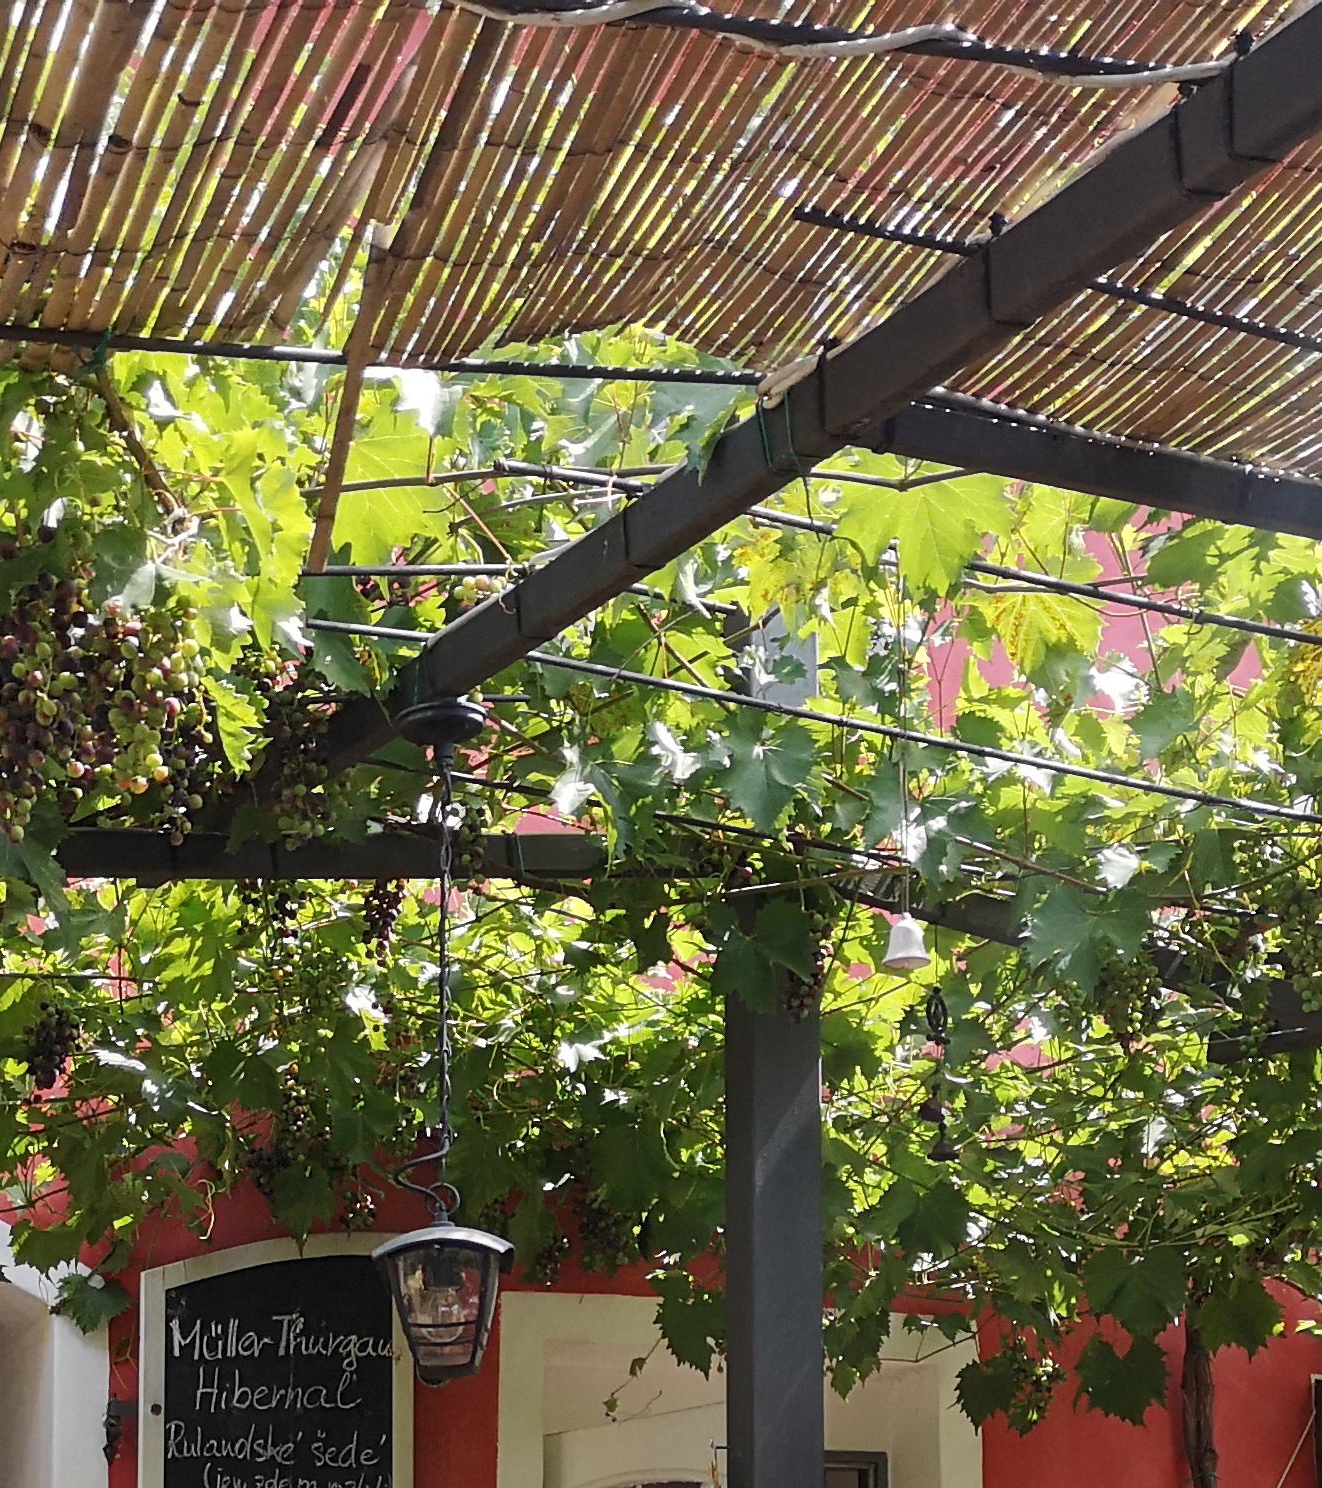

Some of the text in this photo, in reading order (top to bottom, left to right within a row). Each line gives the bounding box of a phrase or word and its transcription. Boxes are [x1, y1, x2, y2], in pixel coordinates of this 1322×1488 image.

[195, 1365, 362, 1414] Hibernal
[166, 1420, 387, 1468] Rulandské šedé
